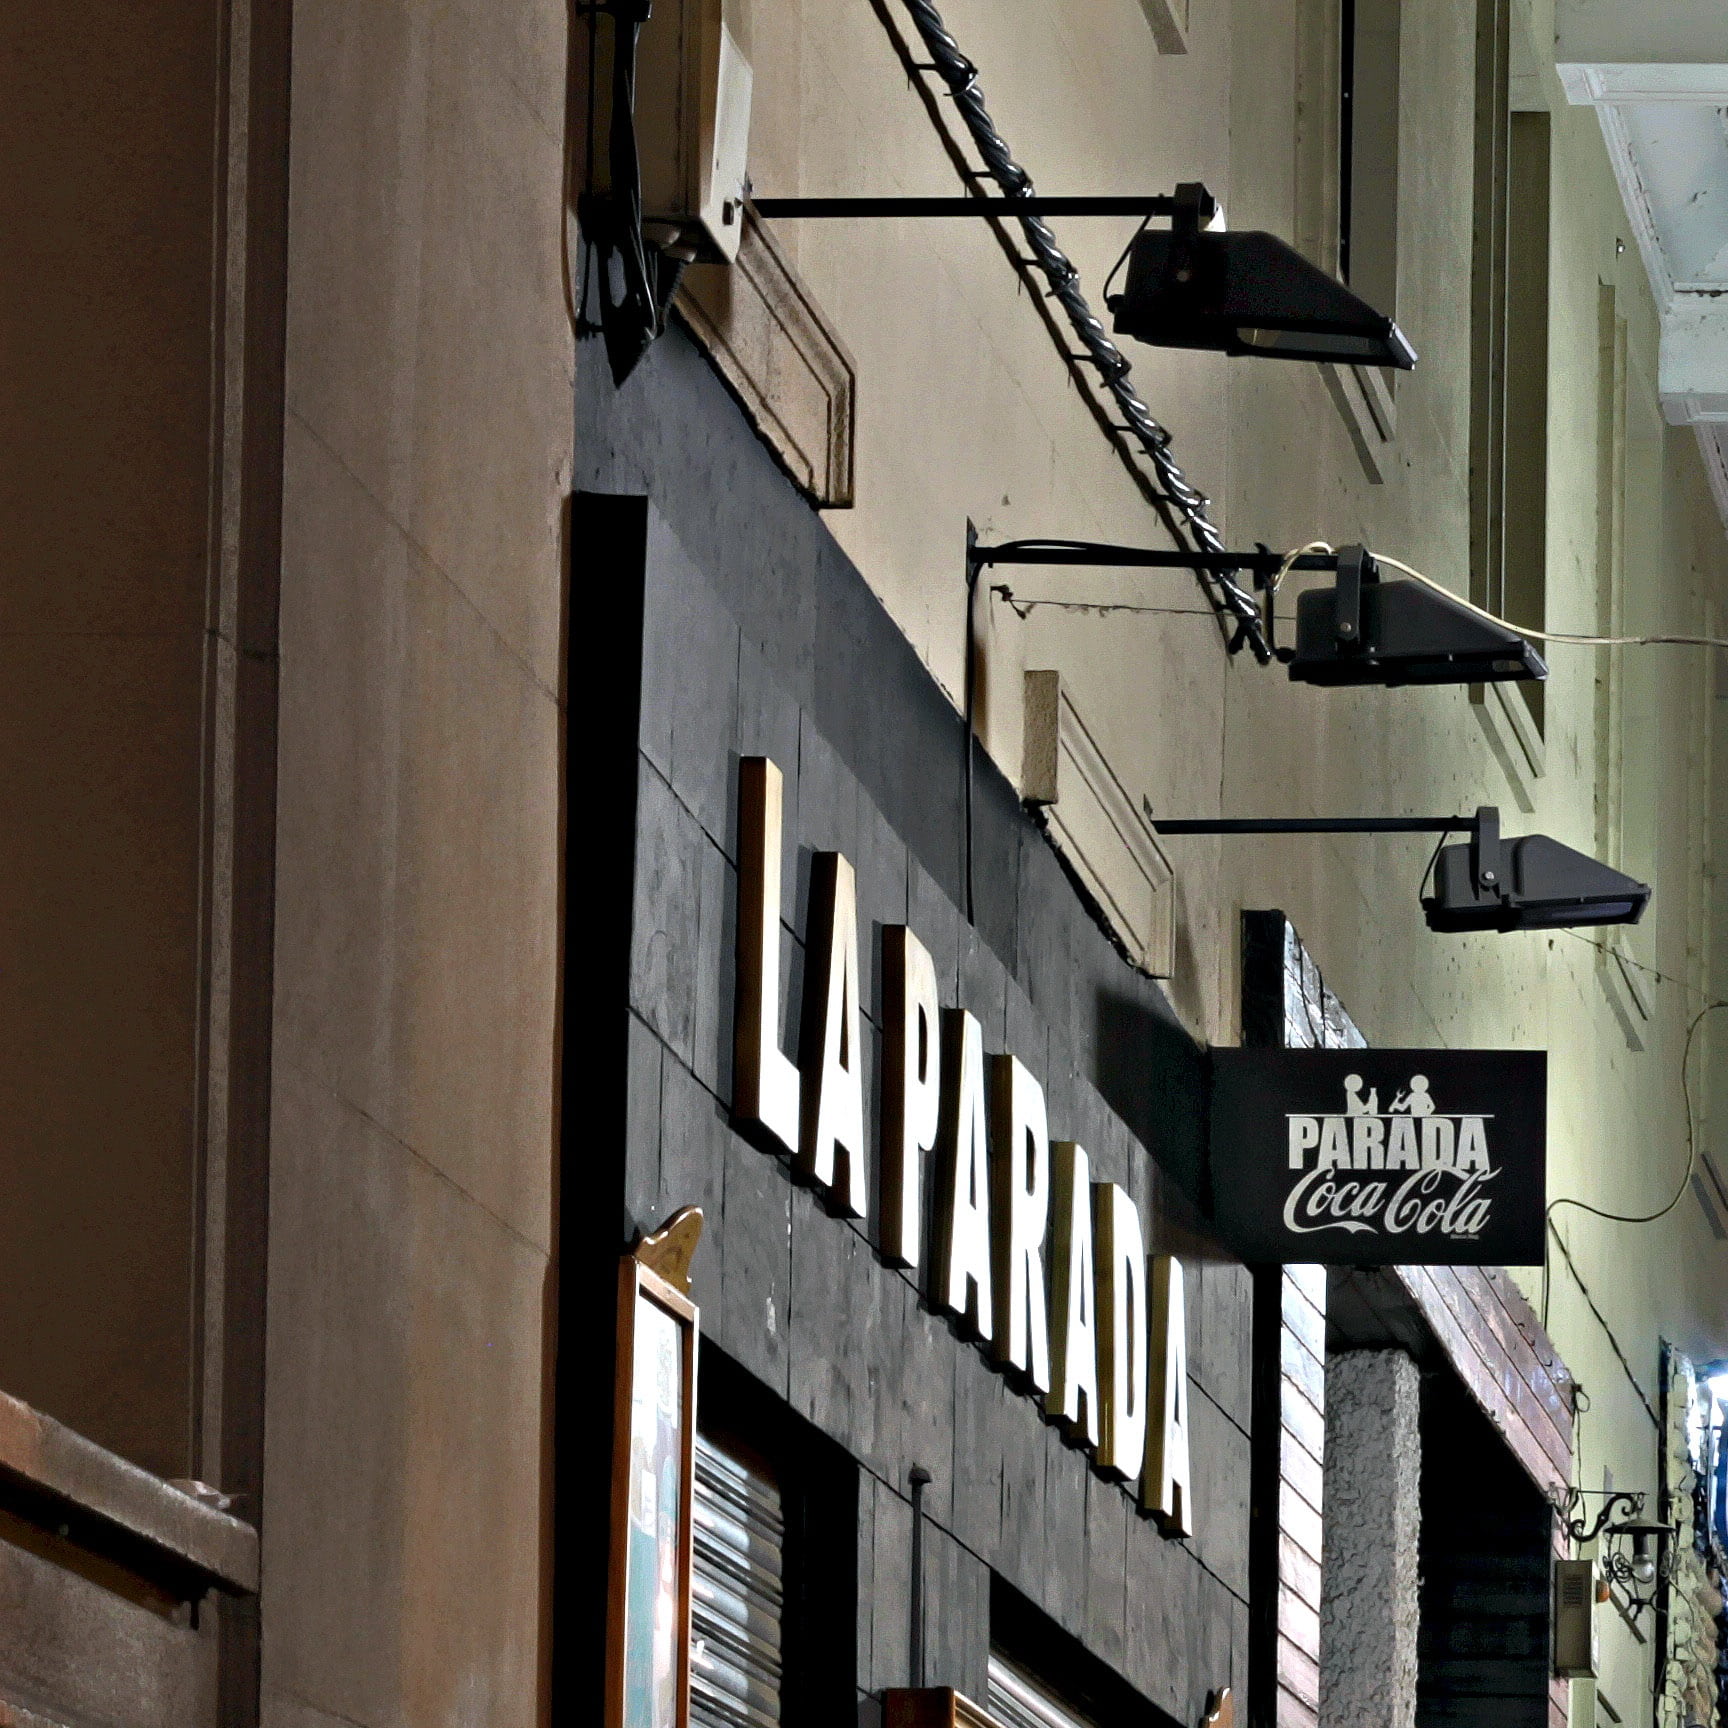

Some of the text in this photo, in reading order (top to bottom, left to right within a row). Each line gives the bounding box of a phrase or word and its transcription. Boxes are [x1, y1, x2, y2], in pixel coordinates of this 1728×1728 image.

[735, 755, 1193, 1539] LA PARADA
[1288, 1116, 1491, 1171] PARADA
